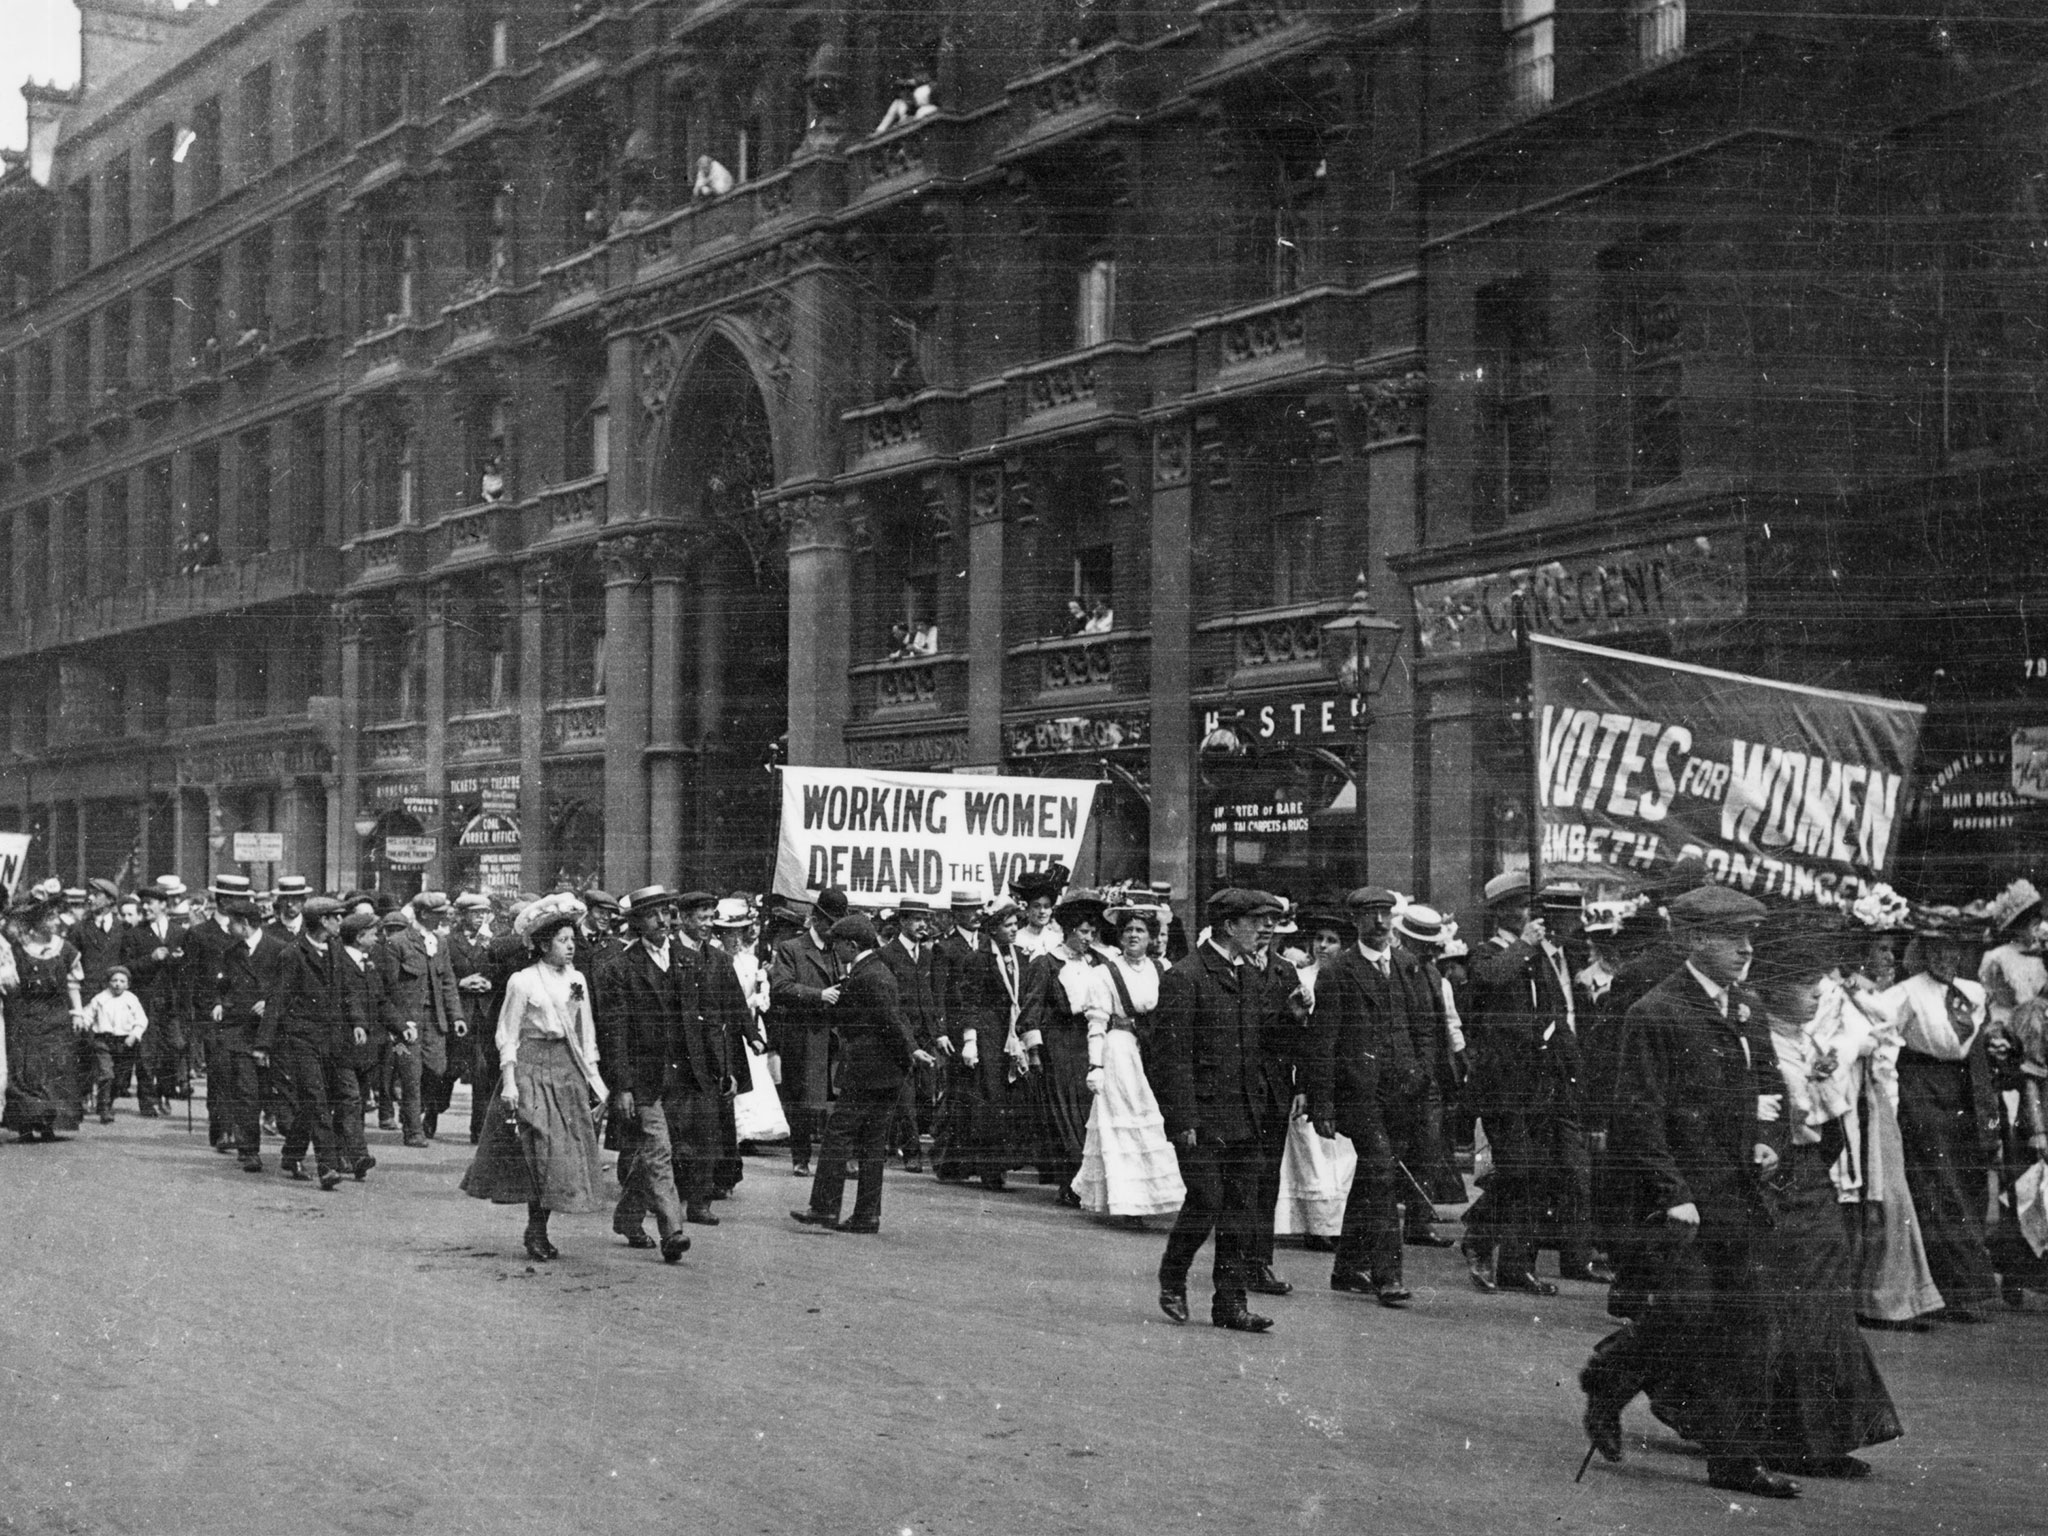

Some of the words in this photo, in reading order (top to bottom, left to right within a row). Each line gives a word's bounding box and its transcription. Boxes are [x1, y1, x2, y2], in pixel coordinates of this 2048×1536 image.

[451, 779, 477, 793] TICKETS
[1538, 705, 1692, 821] VOTES
[1678, 757, 1729, 801] FOR
[1720, 739, 1902, 871] WOMEN
[1942, 793, 1972, 809] HAIR
[1975, 791, 2036, 807] DRESS
[803, 784, 948, 835] WORKING
[964, 791, 1079, 839] WOMEN
[1214, 804, 1258, 818] IMRTER
[1276, 802, 1303, 815] RARE
[1248, 820, 1281, 832] CARPETS
[1287, 818, 1309, 831] RUGS
[492, 830, 517, 843] OFFICE
[1543, 823, 1659, 869] AMBETH
[807, 845, 944, 895] DEMAND
[949, 863, 985, 883] THE
